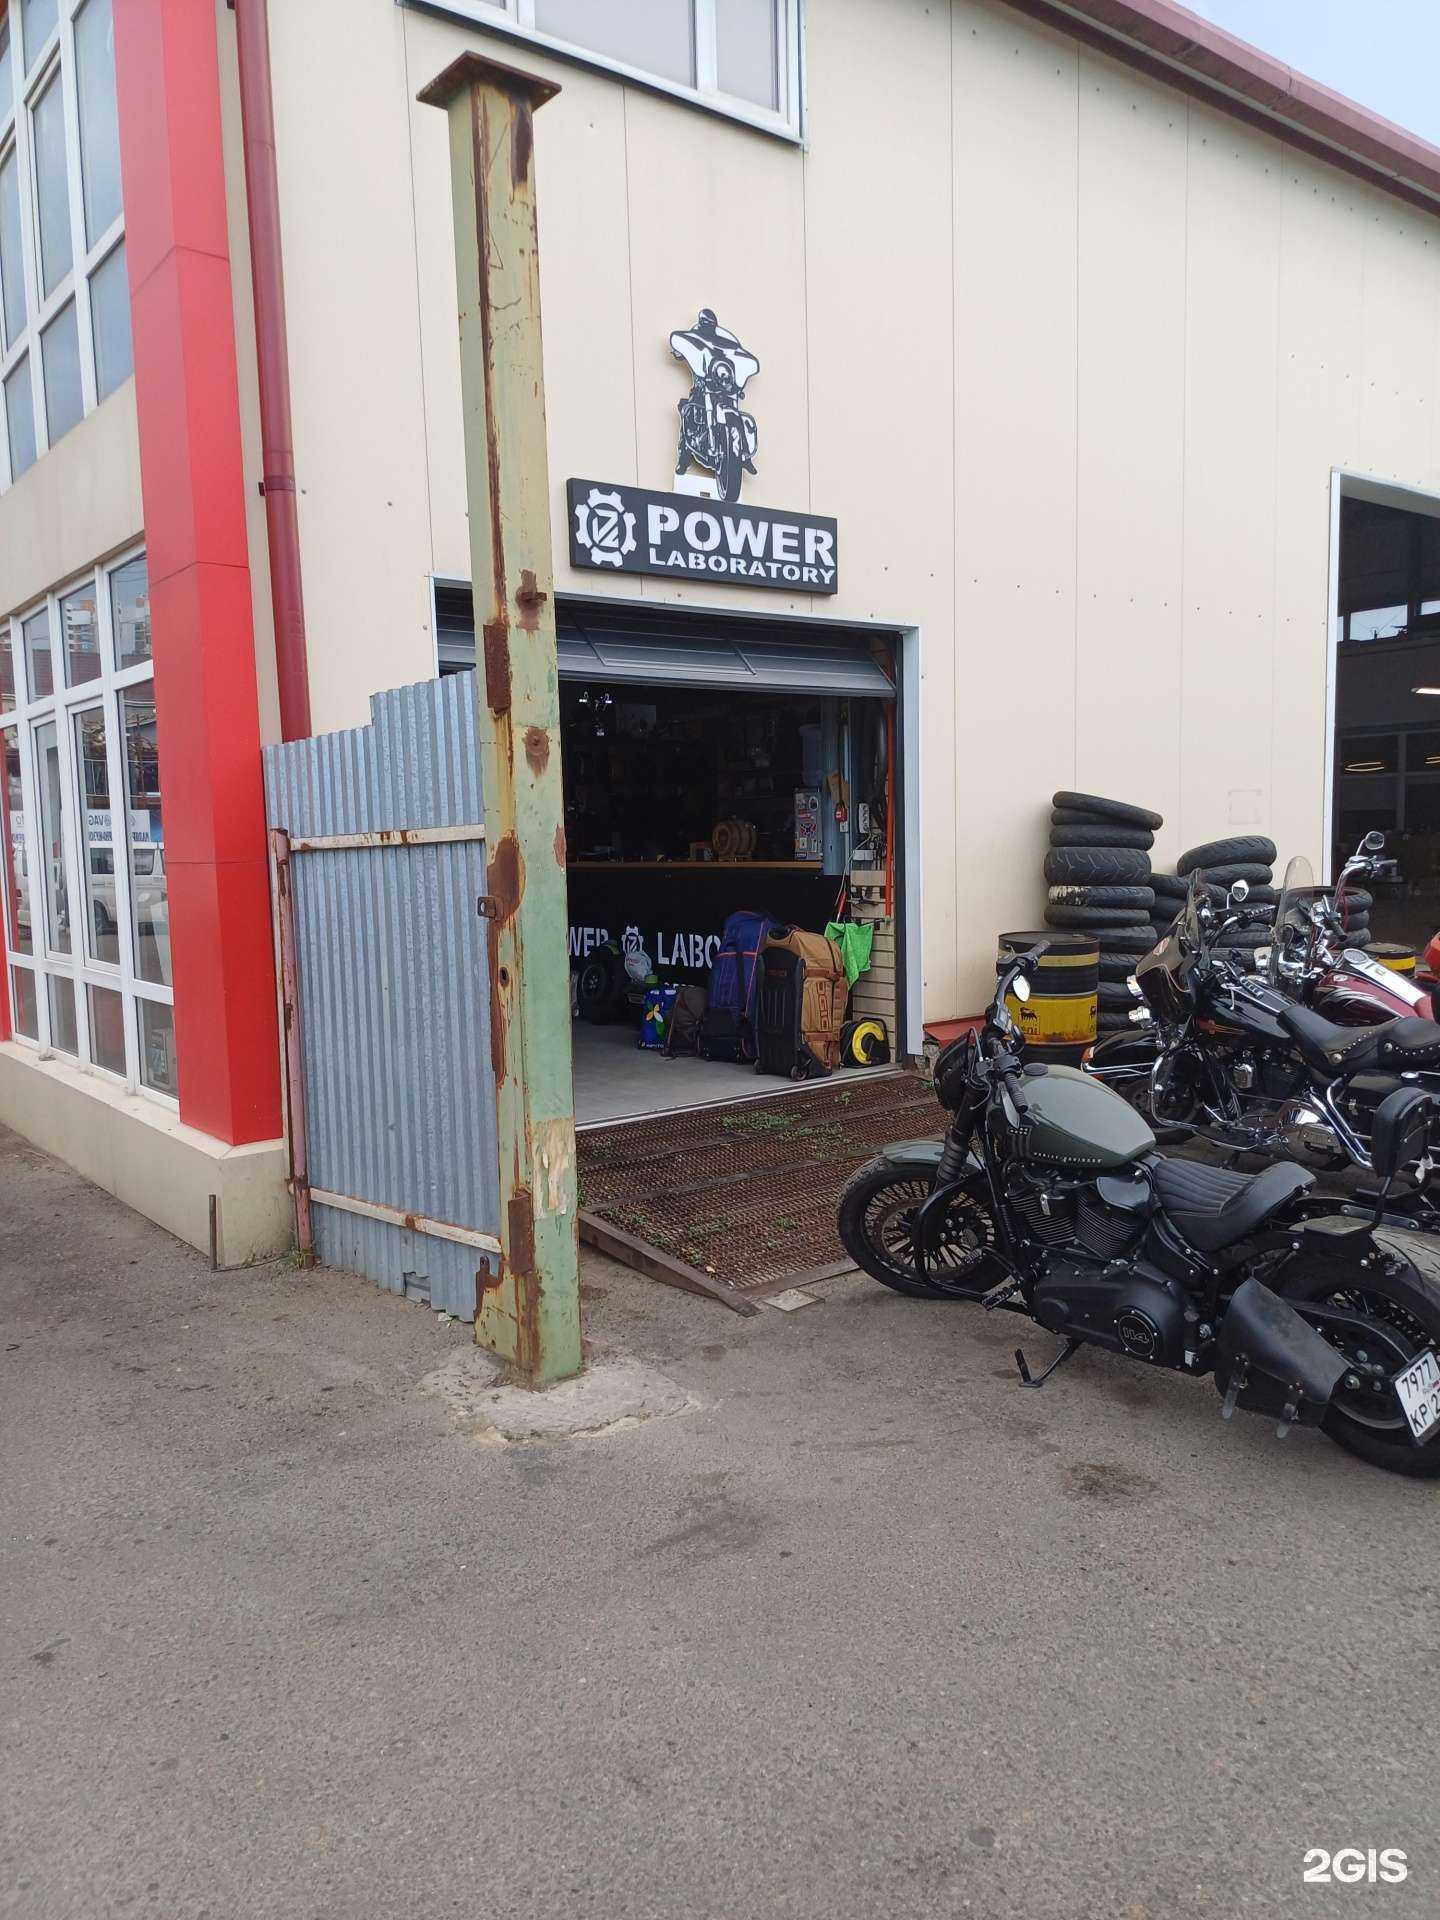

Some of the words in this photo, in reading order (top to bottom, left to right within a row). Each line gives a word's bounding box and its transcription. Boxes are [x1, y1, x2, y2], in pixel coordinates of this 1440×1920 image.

[648, 504, 835, 566] POWER
[649, 548, 835, 584] LABORATORY
[1401, 1358, 1432, 1399] 7977
